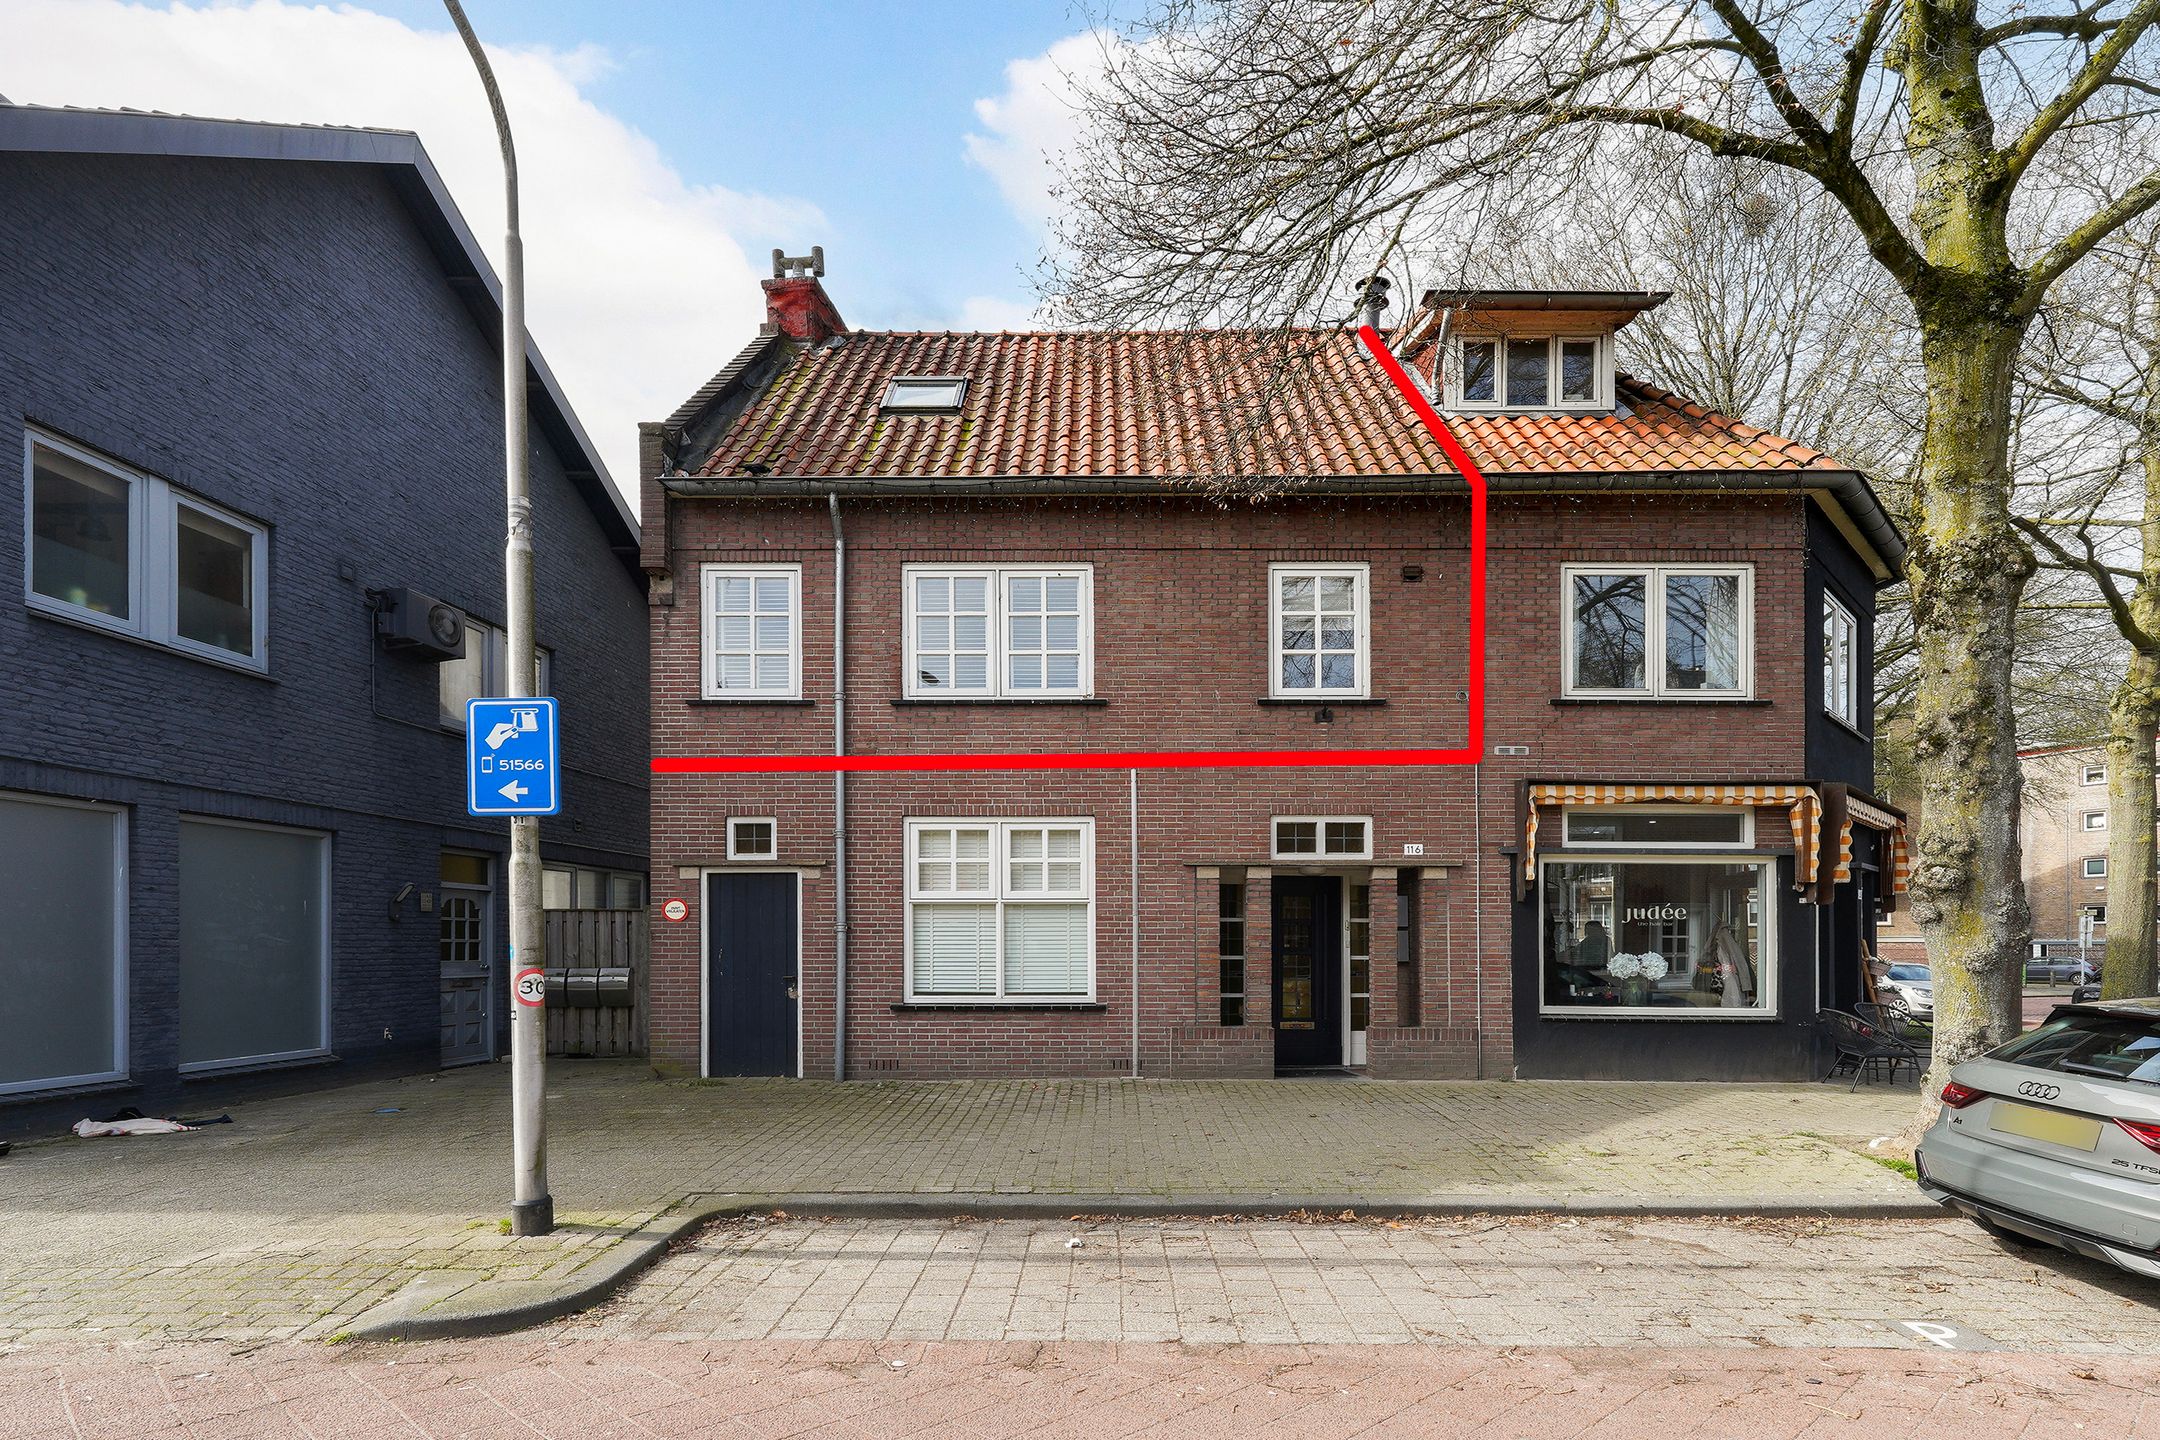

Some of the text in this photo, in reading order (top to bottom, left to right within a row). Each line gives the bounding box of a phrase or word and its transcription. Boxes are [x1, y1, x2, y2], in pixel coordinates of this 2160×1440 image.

[499, 759, 545, 771] 51566
[1406, 845, 1421, 854] 116
[1621, 902, 1687, 924] judée
[520, 980, 545, 995] 30
[2111, 1158, 2130, 1168] 25
[1900, 1320, 1958, 1349] P
